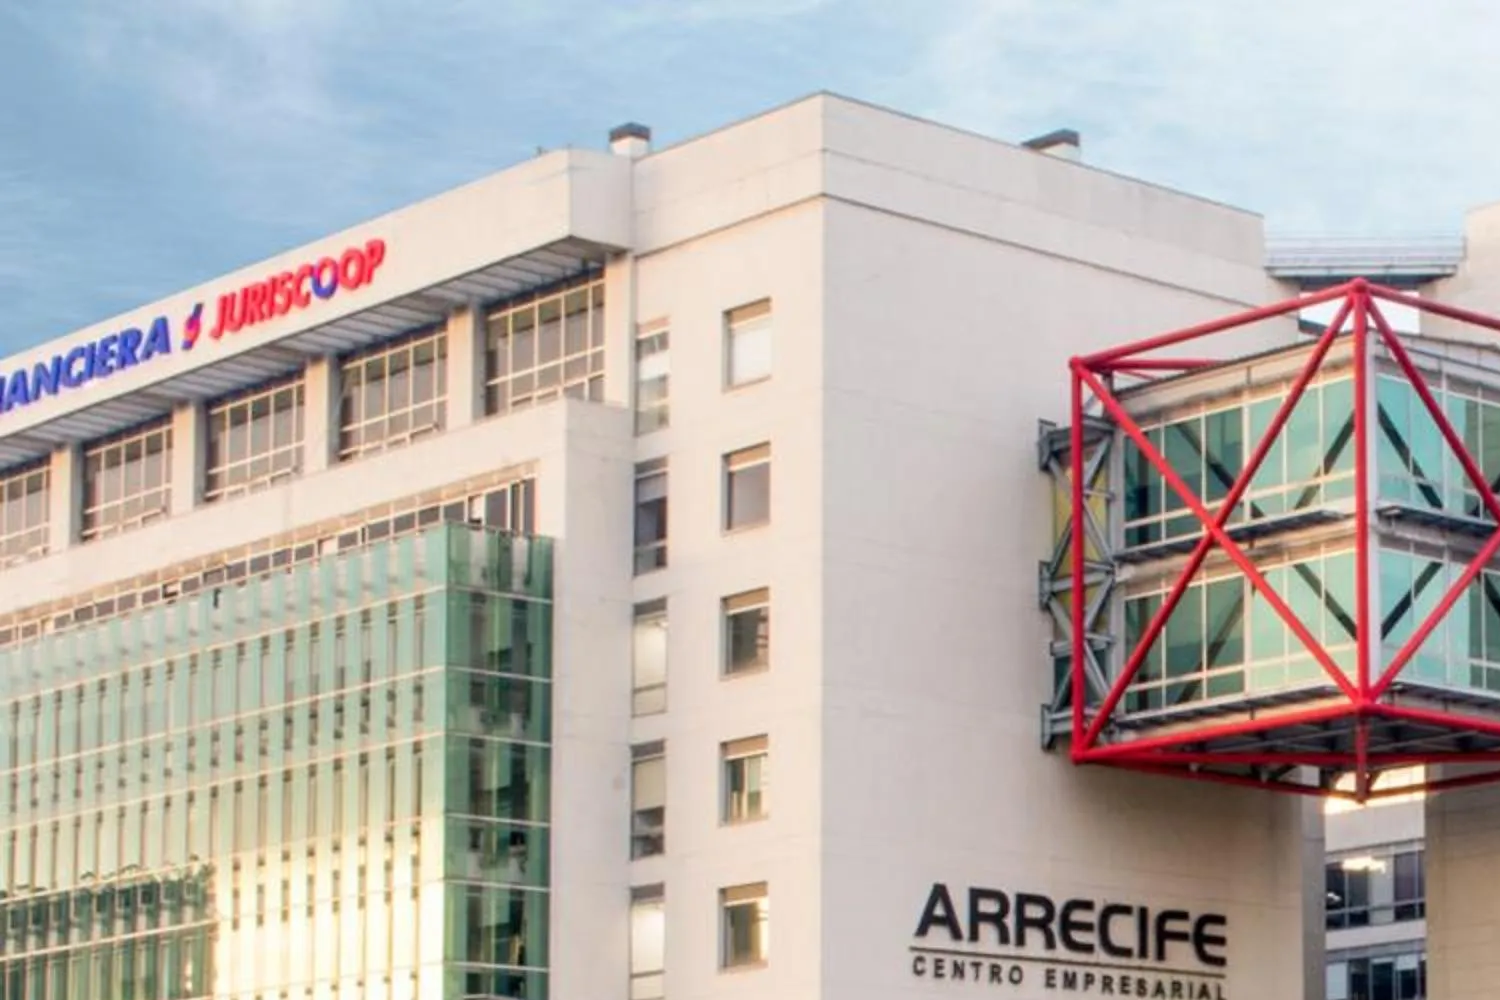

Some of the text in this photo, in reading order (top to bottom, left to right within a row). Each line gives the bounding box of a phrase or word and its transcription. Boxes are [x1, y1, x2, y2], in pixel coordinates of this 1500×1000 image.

[209, 238, 386, 341] JURISCOOP
[914, 882, 1228, 967] ARRECIFE
[911, 955, 1024, 985] CENTRO
